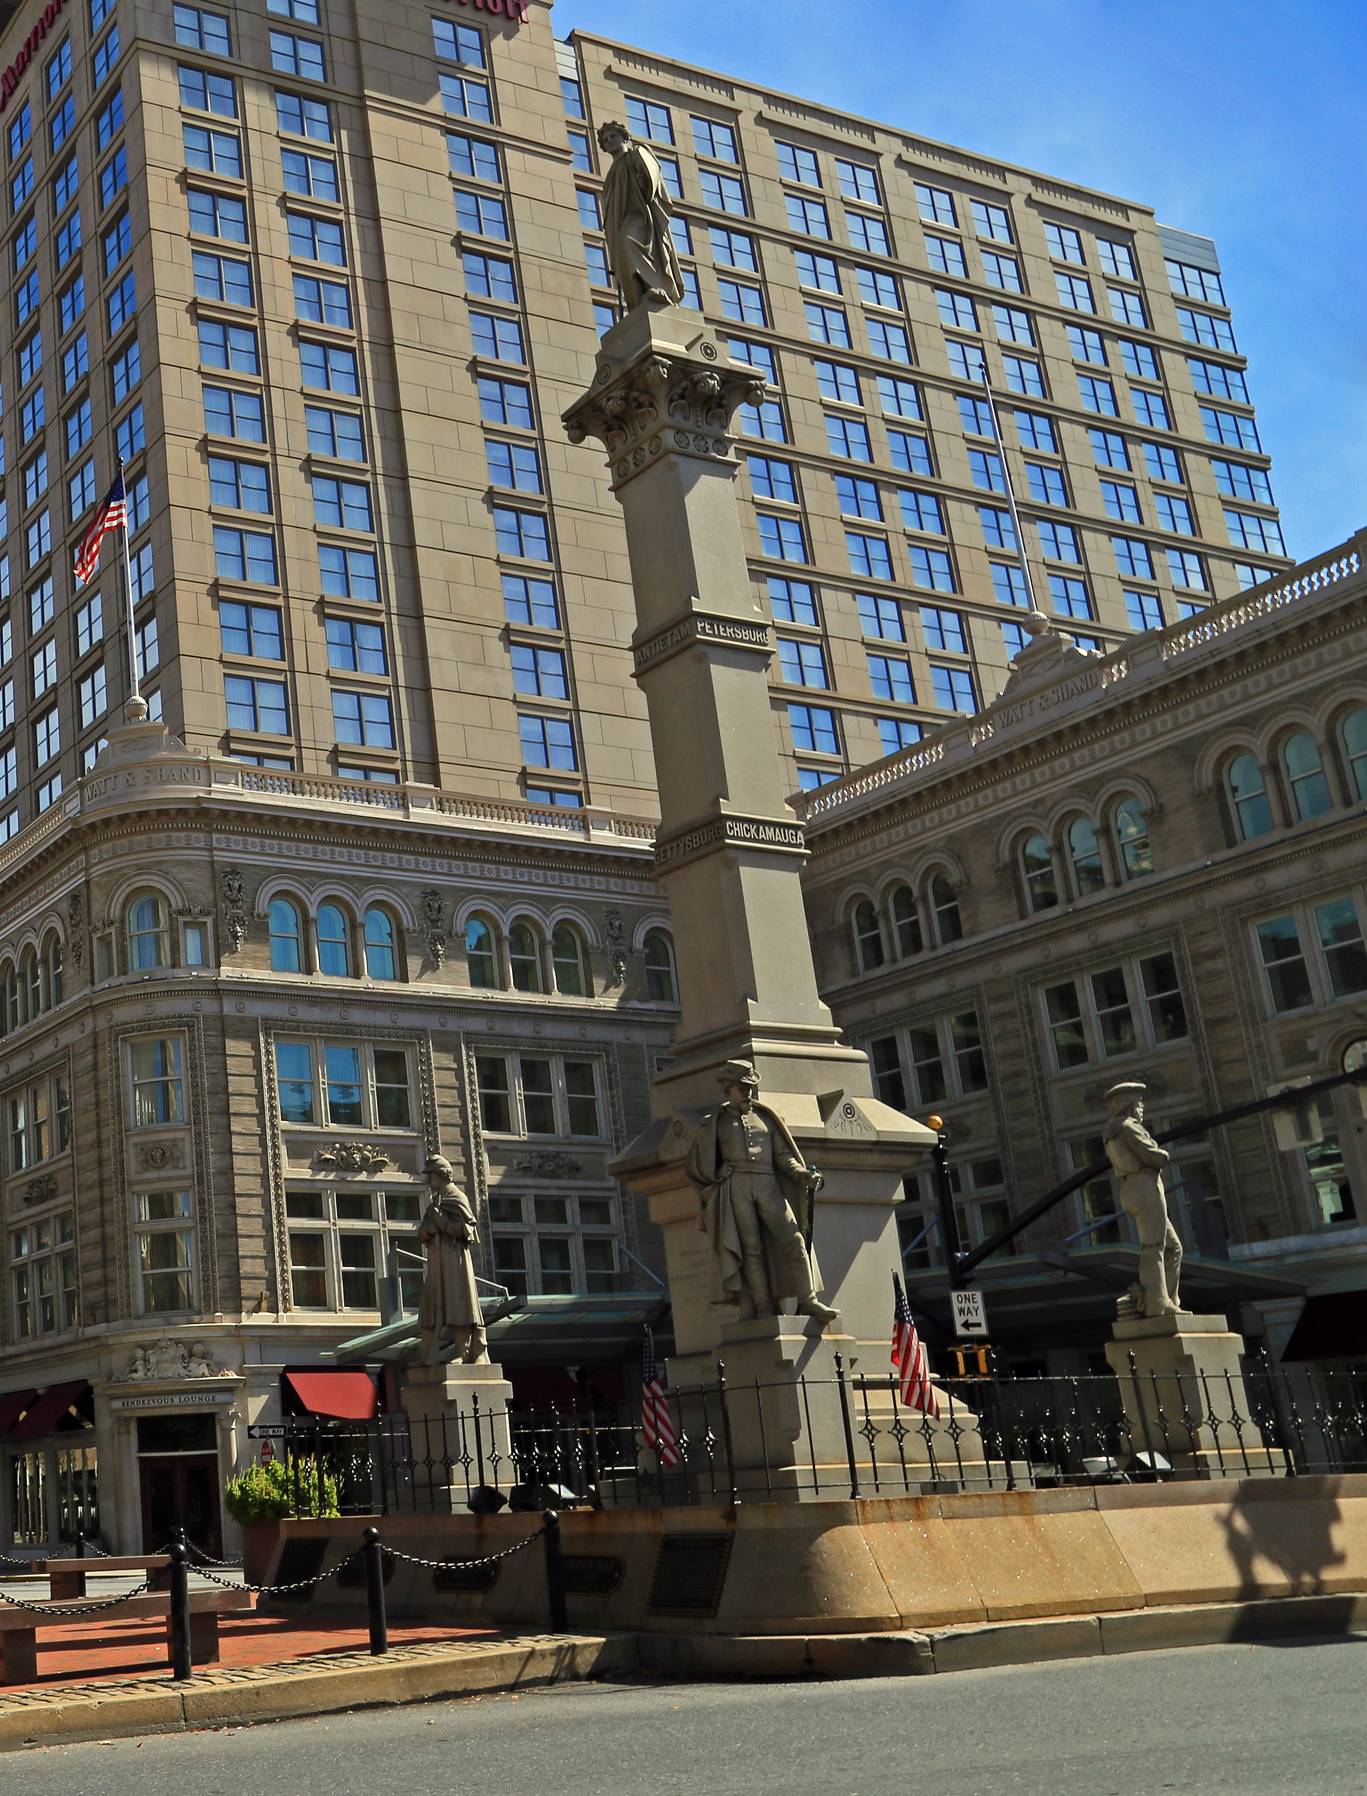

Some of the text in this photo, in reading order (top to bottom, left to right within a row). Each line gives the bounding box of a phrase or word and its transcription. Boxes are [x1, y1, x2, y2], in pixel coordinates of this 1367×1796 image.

[637, 621, 691, 666] ANTIETAM
[696, 619, 770, 644] PETERSBURG
[998, 672, 1098, 729] WATT & SHAND
[85, 766, 203, 802] WATT & SHAND
[654, 824, 723, 865] GETTYSBURG
[725, 820, 805, 845] CHICKAMAUGA
[956, 1293, 978, 1304] ONE
[957, 1306, 980, 1317] WAY
[121, 1395, 216, 1407] RENDEZVOUS LOUNGE
